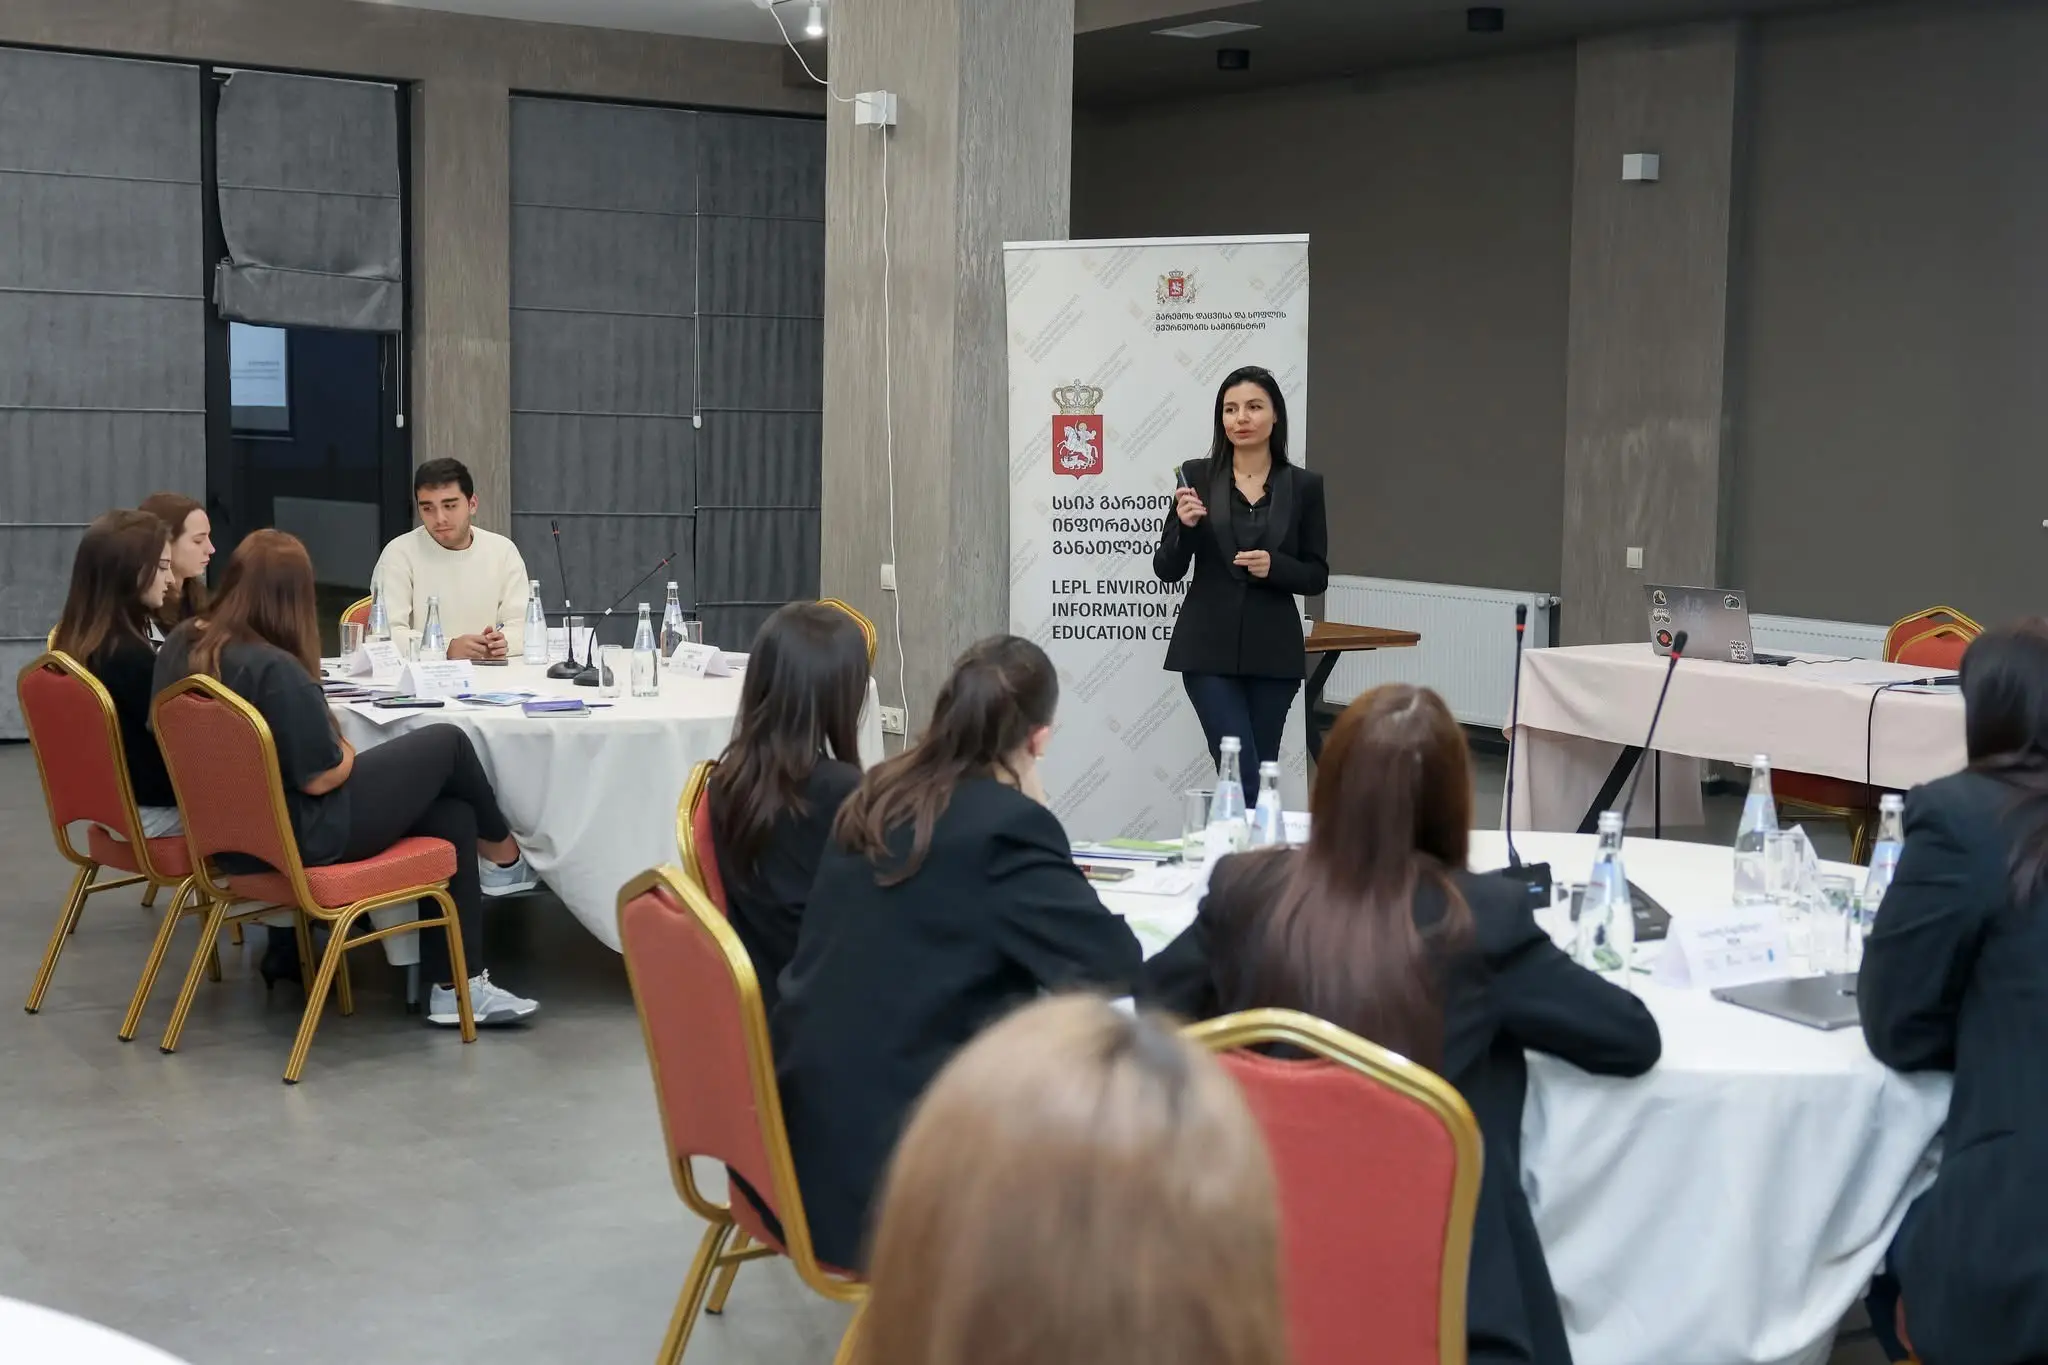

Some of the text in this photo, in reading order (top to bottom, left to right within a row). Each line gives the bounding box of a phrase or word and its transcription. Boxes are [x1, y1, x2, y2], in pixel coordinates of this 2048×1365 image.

[1234, 311, 1246, 319] და
[1052, 495, 1095, 510] სსიპ
[1052, 580, 1092, 594] LEPL
[1052, 602, 1167, 618] INFORMATION
[1052, 625, 1176, 641] EDUCATION CE
